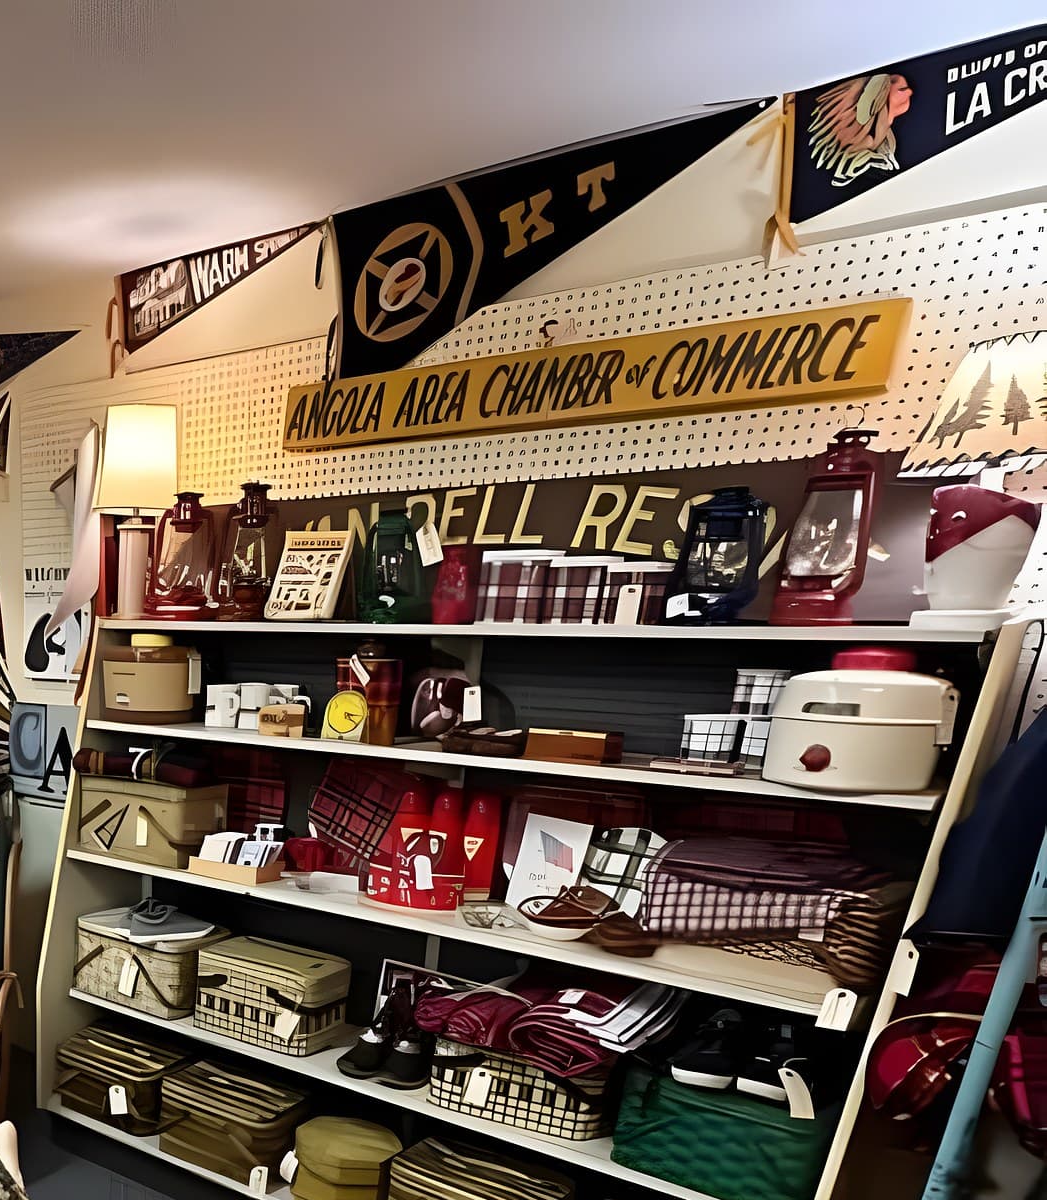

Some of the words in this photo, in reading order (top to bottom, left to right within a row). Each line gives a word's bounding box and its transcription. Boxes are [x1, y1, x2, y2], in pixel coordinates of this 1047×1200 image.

[945, 82, 992, 136] LA
[499, 189, 555, 259] K
[577, 161, 615, 213] T
[286, 381, 387, 441] ANGOLA
[392, 368, 471, 428] AREA
[479, 350, 626, 419] CHAMBER
[652, 314, 882, 401] COMMERCE
